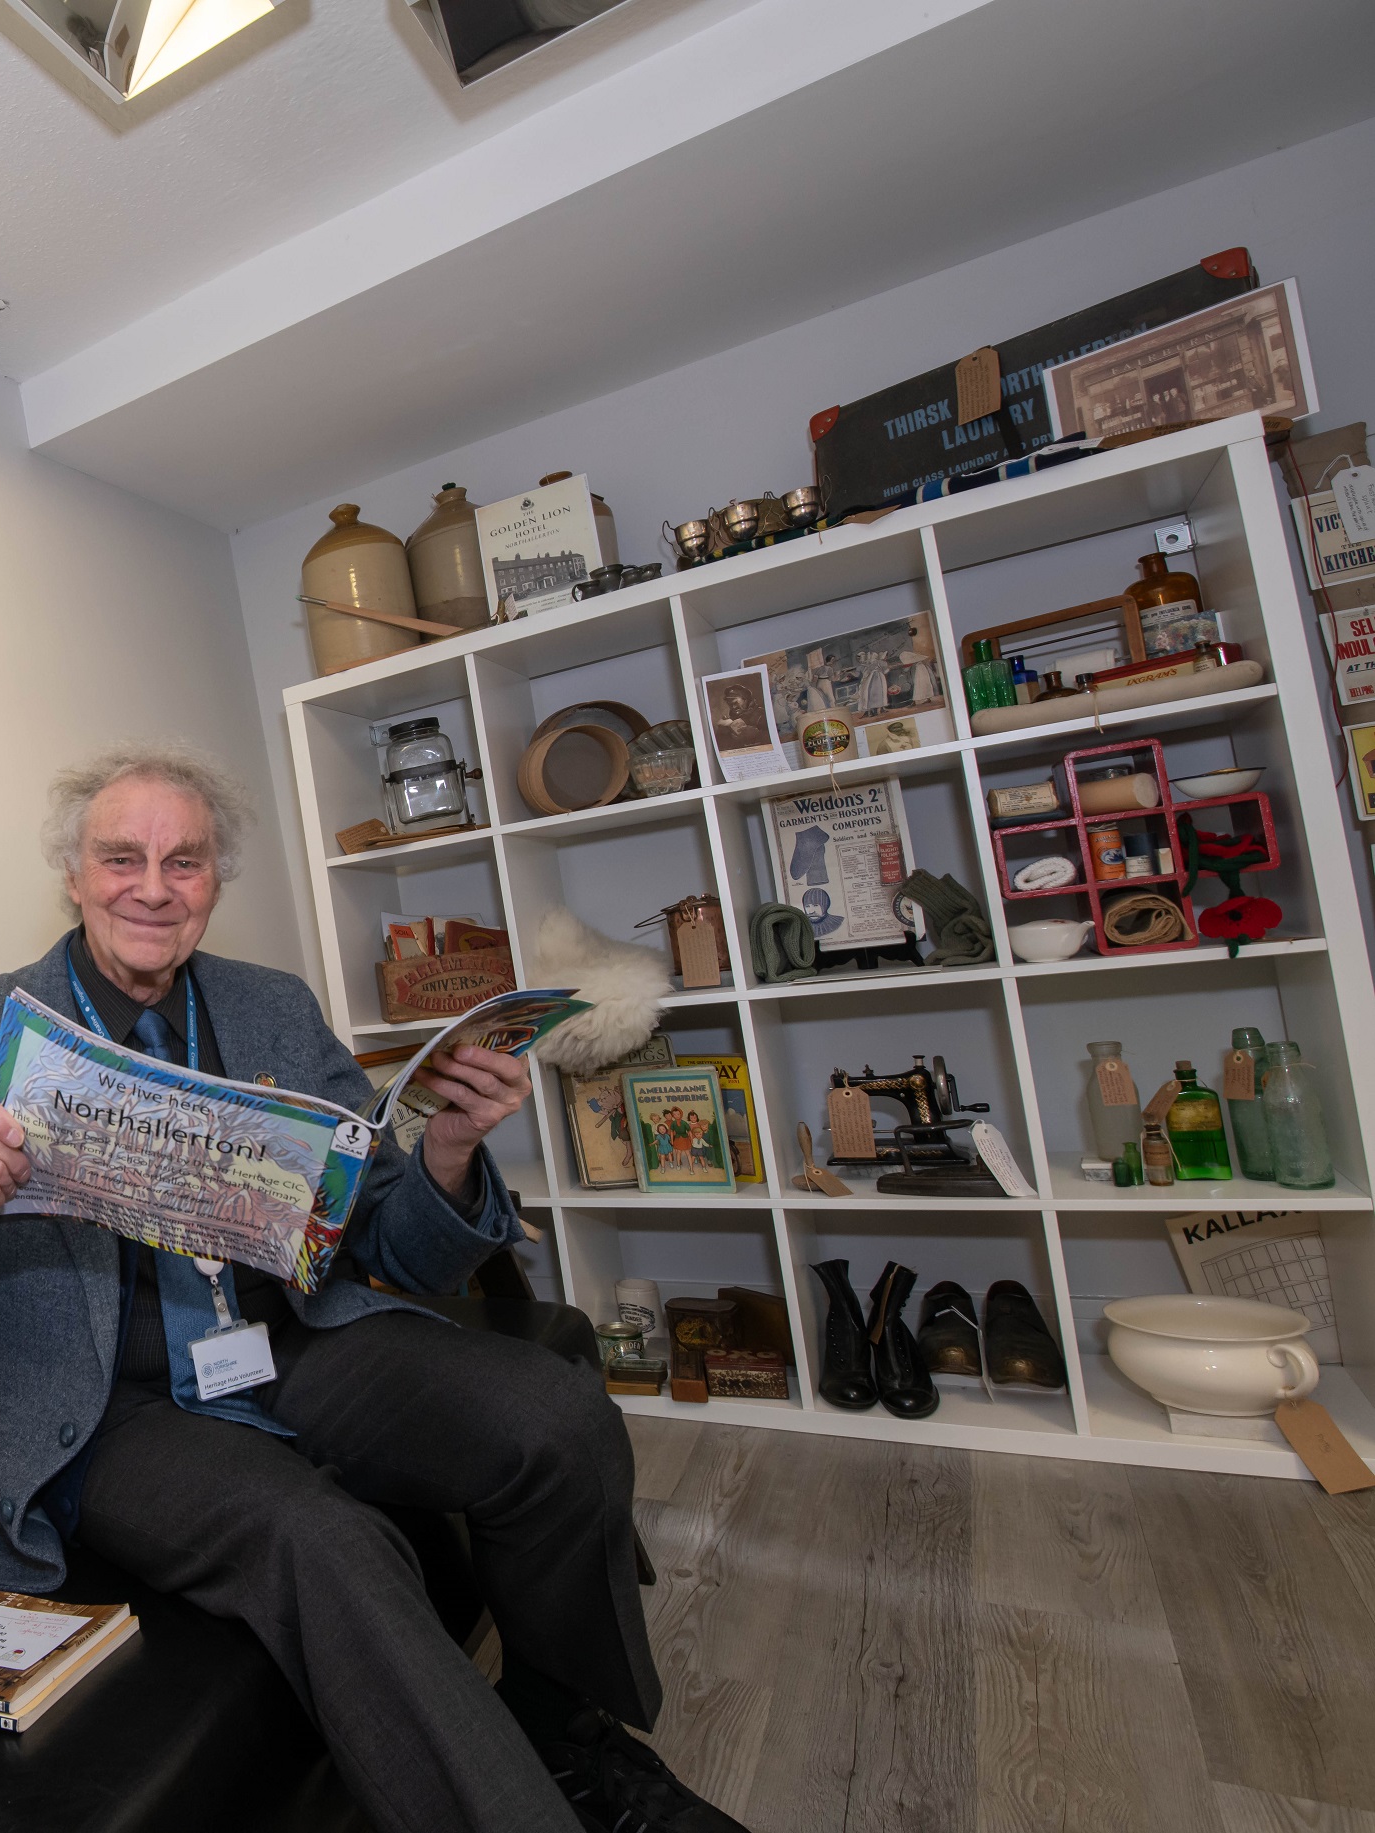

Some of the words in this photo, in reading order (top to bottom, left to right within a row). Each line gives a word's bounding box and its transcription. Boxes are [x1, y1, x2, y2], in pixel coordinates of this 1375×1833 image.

[883, 399, 952, 440] THIRSK
[941, 398, 1034, 450] LAUNRY
[883, 482, 908, 498] HIGH
[912, 469, 945, 488] CLASS
[948, 452, 999, 475] LAUNDRY
[490, 517, 537, 538] GOLDEN
[542, 505, 572, 522] LION
[515, 524, 547, 539] HOTEL
[504, 528, 560, 550] NORTHALLERTON
[1126, 668, 1177, 686] INGRAM'S
[1346, 664, 1360, 672] AT
[808, 738, 829, 747] PLUM
[792, 793, 864, 814] Weldon's
[779, 813, 829, 828] GARMENTS
[839, 804, 886, 818] HOSPITAL
[832, 816, 882, 831] COMFORTS
[628, 1049, 665, 1063] PIGS
[100, 1072, 126, 1093] We
[132, 1084, 162, 1104] live
[637, 1095, 663, 1104] GOES
[665, 1094, 709, 1103] TOURING
[639, 1085, 707, 1095] AMELIARANNE
[54, 1089, 266, 1161] Northallerton!
[12, 1109, 30, 1124] This
[32, 1118, 81, 1138] children's
[84, 1131, 111, 1146] book
[114, 1142, 133, 1152] was
[134, 1146, 173, 1161] created
[176, 1155, 190, 1166] by
[193, 1157, 229, 1174] Dream
[232, 1168, 280, 1188] Heritage
[61, 1140, 76, 1149] on
[79, 1142, 106, 1156] from
[116, 1151, 148, 1167] school
[154, 1161, 174, 1175] visit
[179, 1166, 191, 1176] to
[193, 1172, 254, 1193] Applegarth
[257, 1186, 302, 1204] Primary
[36, 1168, 54, 1177] Who
[57, 1173, 77, 1182] knew
[79, 1180, 134, 1200] Northallerton
[160, 1204, 184, 1214] place
[207, 1213, 232, 1224] much
[101, 1172, 140, 1189] enjoyable
[143, 1184, 162, 1194] read
[163, 1188, 176, 1198] for
[28, 1180, 55, 1189] money
[57, 1185, 82, 1196] raised
[162, 1216, 195, 1229] support
[197, 1222, 210, 1230] the
[212, 1227, 250, 1239] valuable
[16, 1193, 44, 1201] enable
[46, 1195, 67, 1205] them
[159, 1230, 200, 1244] renewing
[202, 1238, 218, 1247] and
[220, 1242, 258, 1258] restoring
[259, 1255, 279, 1265] both
[155, 1222, 182, 1233] Dream
[185, 1228, 220, 1241] Heritage
[243, 1242, 262, 1251] and
[263, 1248, 277, 1257] will
[214, 1360, 238, 1370] YORKSHIRE
[706, 1349, 777, 1360] OXO
[204, 1380, 227, 1390] Heritage
[239, 1368, 264, 1380] Volunteer
